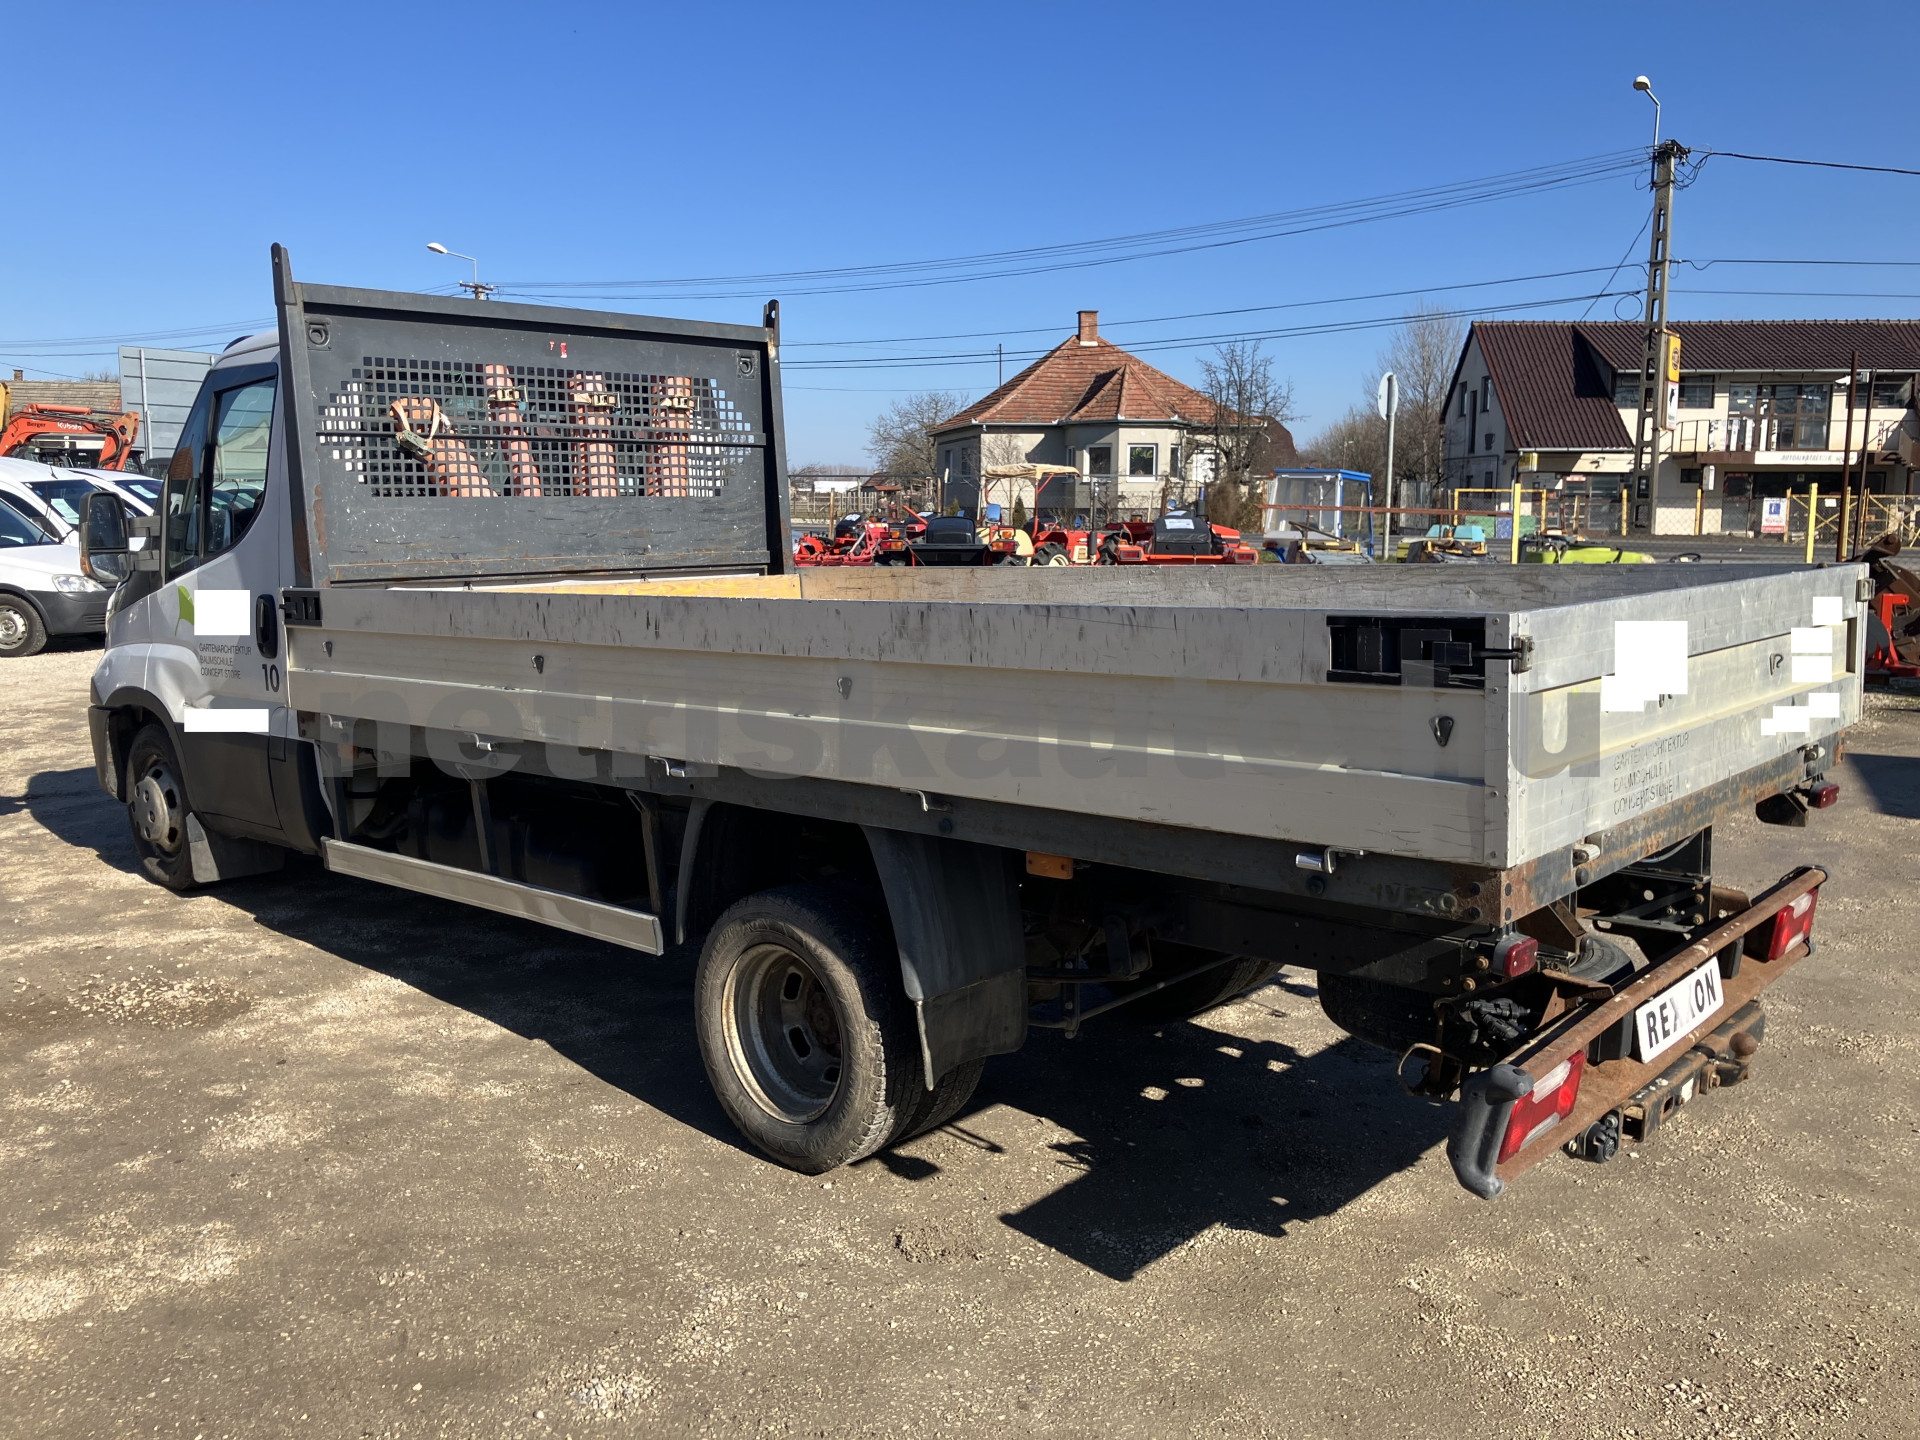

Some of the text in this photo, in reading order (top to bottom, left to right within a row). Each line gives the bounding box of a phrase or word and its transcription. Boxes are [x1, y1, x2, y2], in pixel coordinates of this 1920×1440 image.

[198, 643, 252, 656] GARTENARCHITEKTUR
[199, 656, 233, 666] BAUMSCHULE
[200, 667, 241, 679] CONCEPT STORE
[261, 663, 280, 693] 10
[1613, 732, 1690, 770] GARTENRCHITEKTUR
